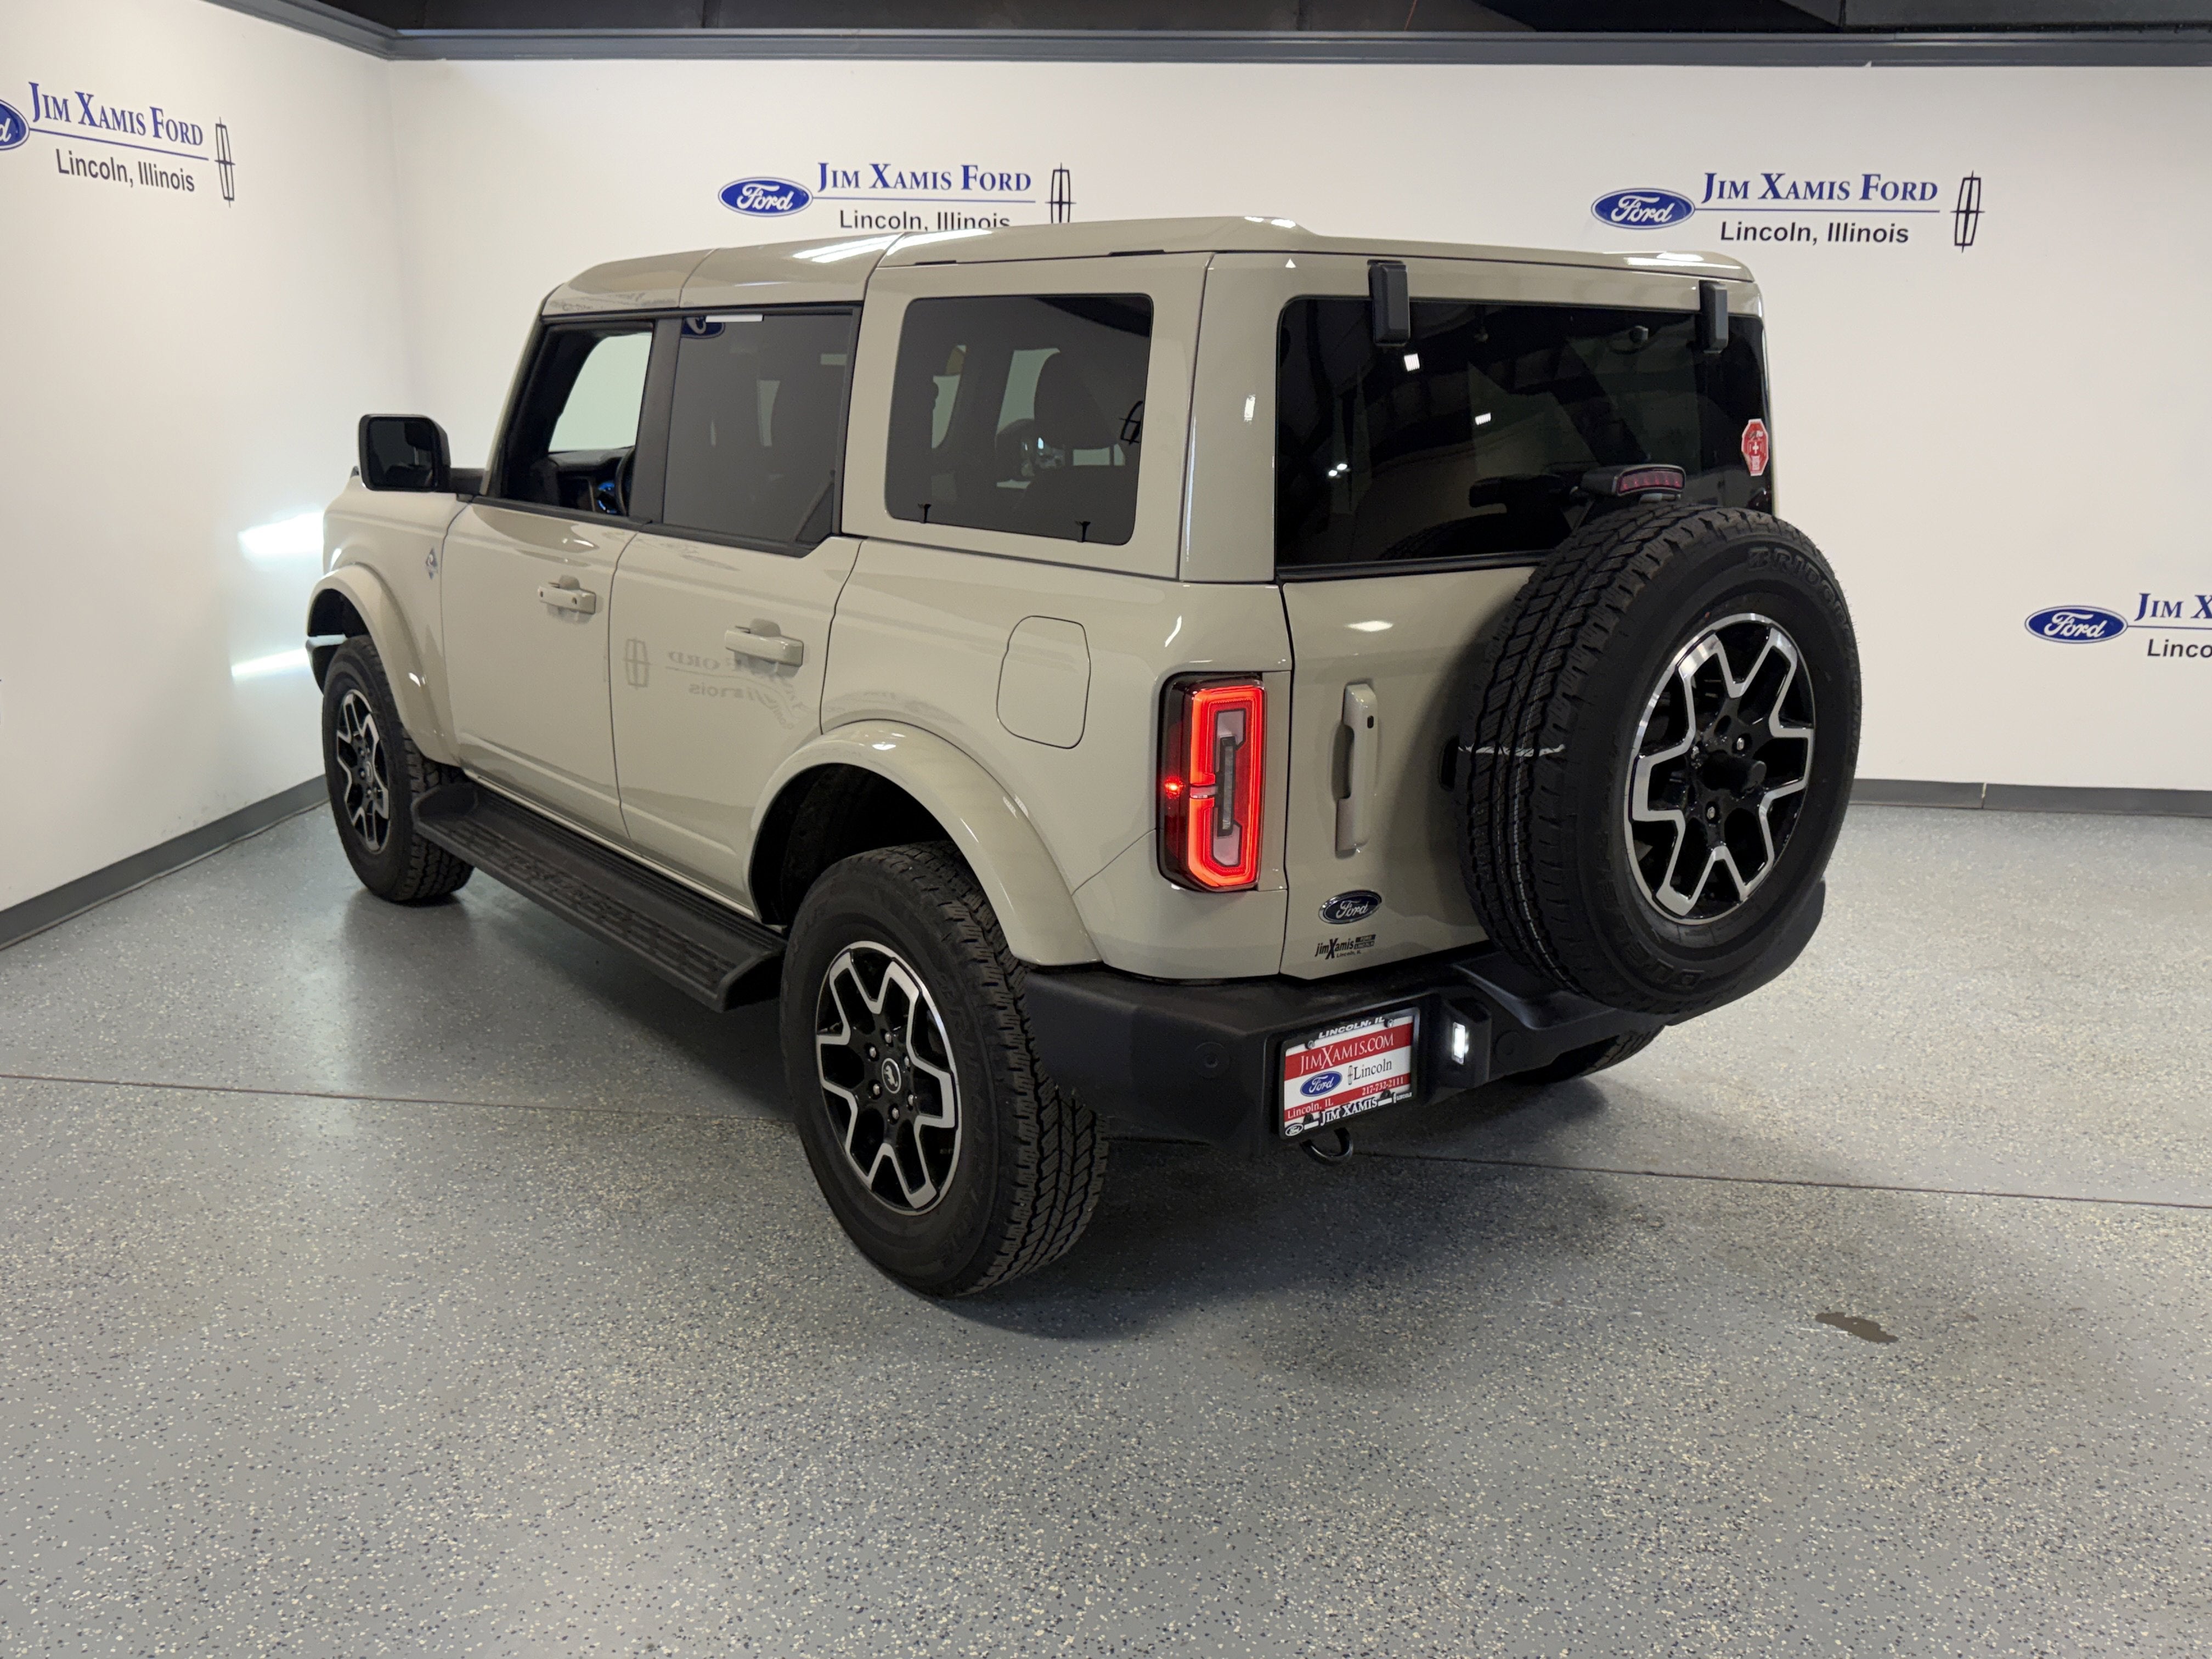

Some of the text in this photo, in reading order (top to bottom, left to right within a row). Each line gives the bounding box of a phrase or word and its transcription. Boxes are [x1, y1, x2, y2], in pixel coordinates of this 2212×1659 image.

[29, 81, 203, 145] JIM XAMIS FORD
[56, 149, 195, 191] Lincoln, Illinois
[818, 162, 1031, 192] JIM XAMIS FORD
[736, 183, 794, 212] Ford
[1701, 172, 1938, 204] JIM XAMIS FORD
[840, 210, 1009, 231] Lincoln, Illinois
[1610, 195, 1673, 224] Ford
[1720, 221, 1909, 246] Lincoln, Illinois
[2134, 593, 2183, 622] JIM
[2044, 611, 2108, 638] Ford
[1335, 899, 1369, 919] Ford
[1318, 1018, 1372, 1039] LINCOLN,
[1300, 1033, 1394, 1075] JIMXAMIS.COM
[1308, 1073, 1334, 1093] Ford
[1353, 1058, 1392, 1080] Lincoln
[1362, 1076, 1404, 1096] 217-732-2111
[1288, 1098, 1334, 1119] Lincoln, IL
[1321, 1097, 1378, 1126] JIM XAMIS
